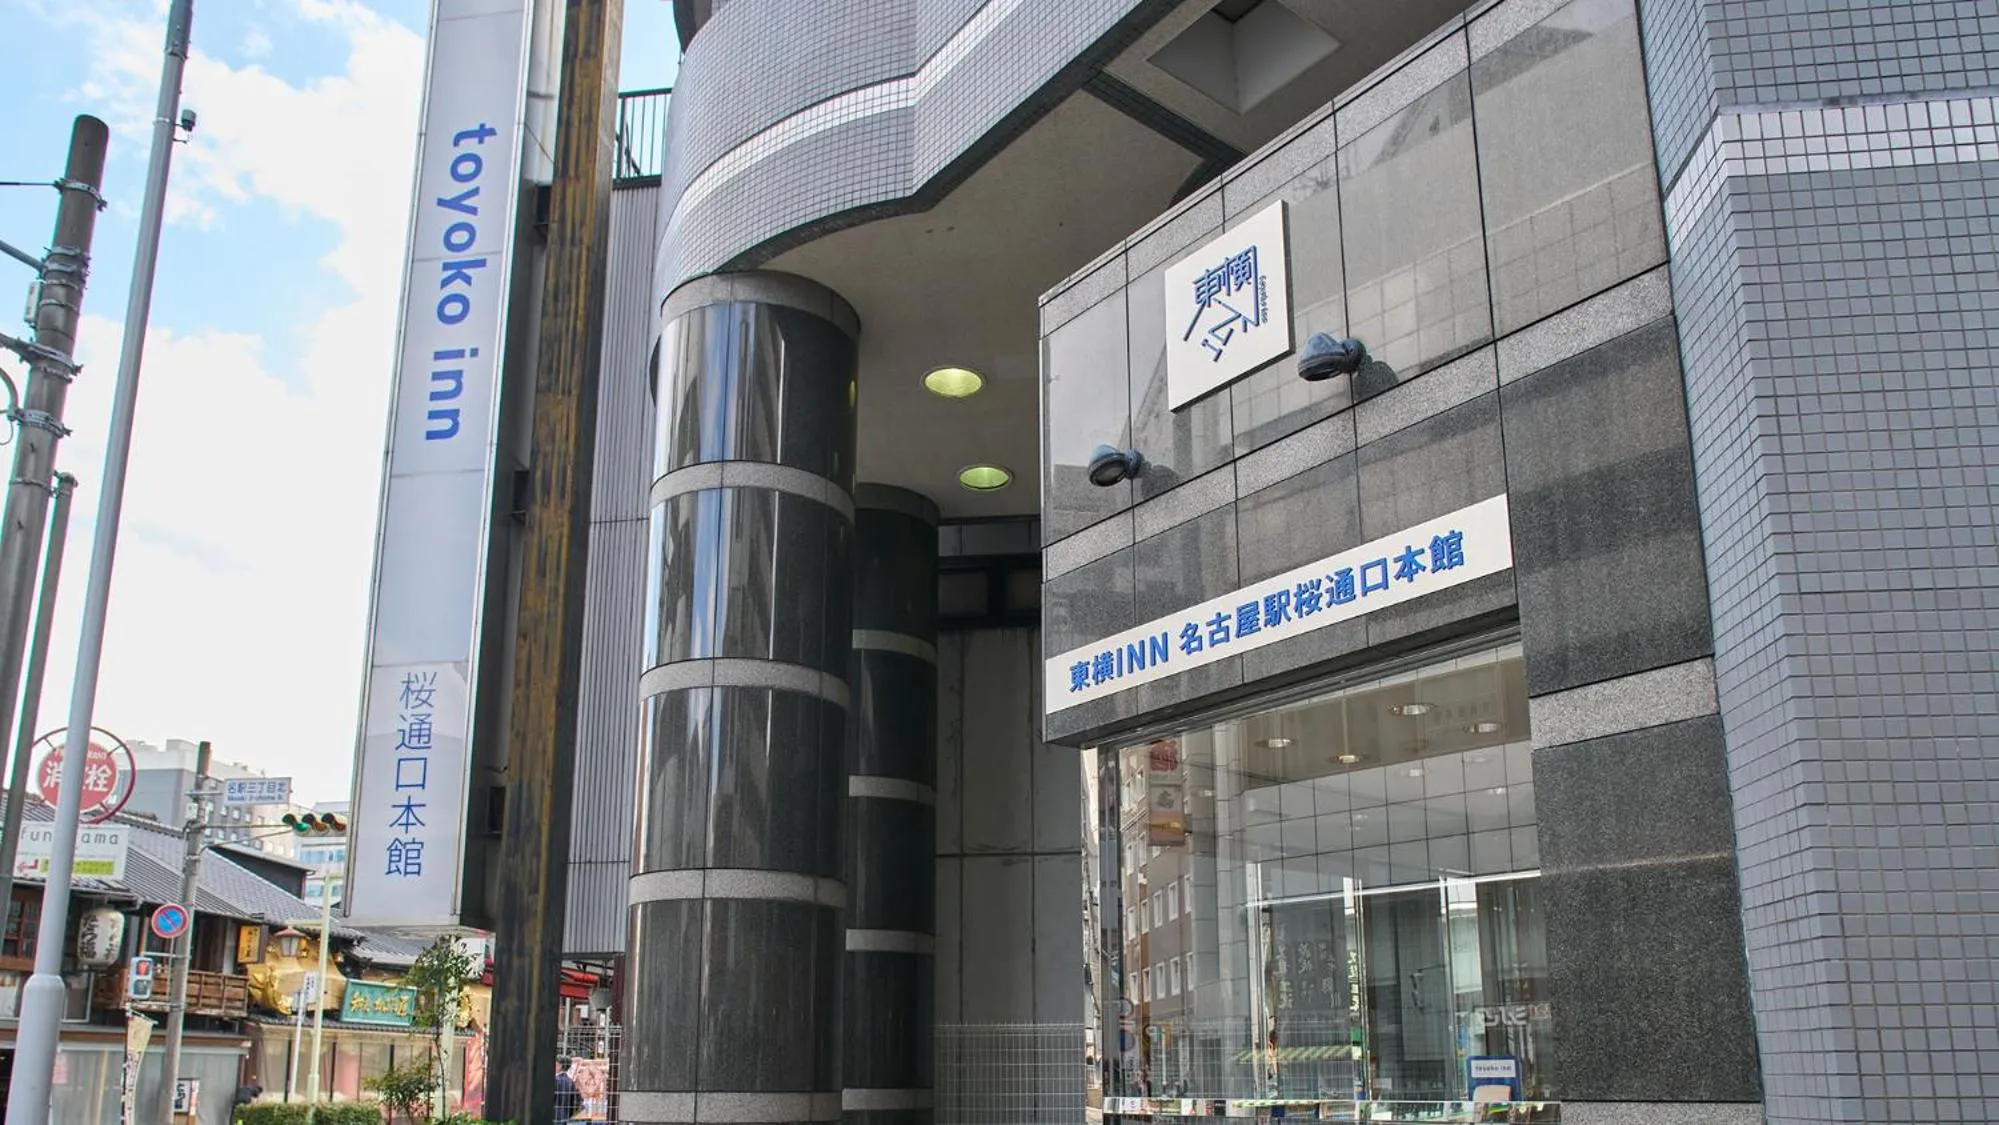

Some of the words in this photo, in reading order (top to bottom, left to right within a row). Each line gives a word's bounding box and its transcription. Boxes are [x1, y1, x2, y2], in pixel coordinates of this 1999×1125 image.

[437, 123, 497, 325] toyoko
[425, 347, 479, 440] inn
[1070, 632, 1169, 692] 東横INN
[1180, 530, 1465, 655] 名古屋駅桜通口本館
[43, 761, 113, 791] 消栓
[384, 671, 437, 877] 桜通口本館
